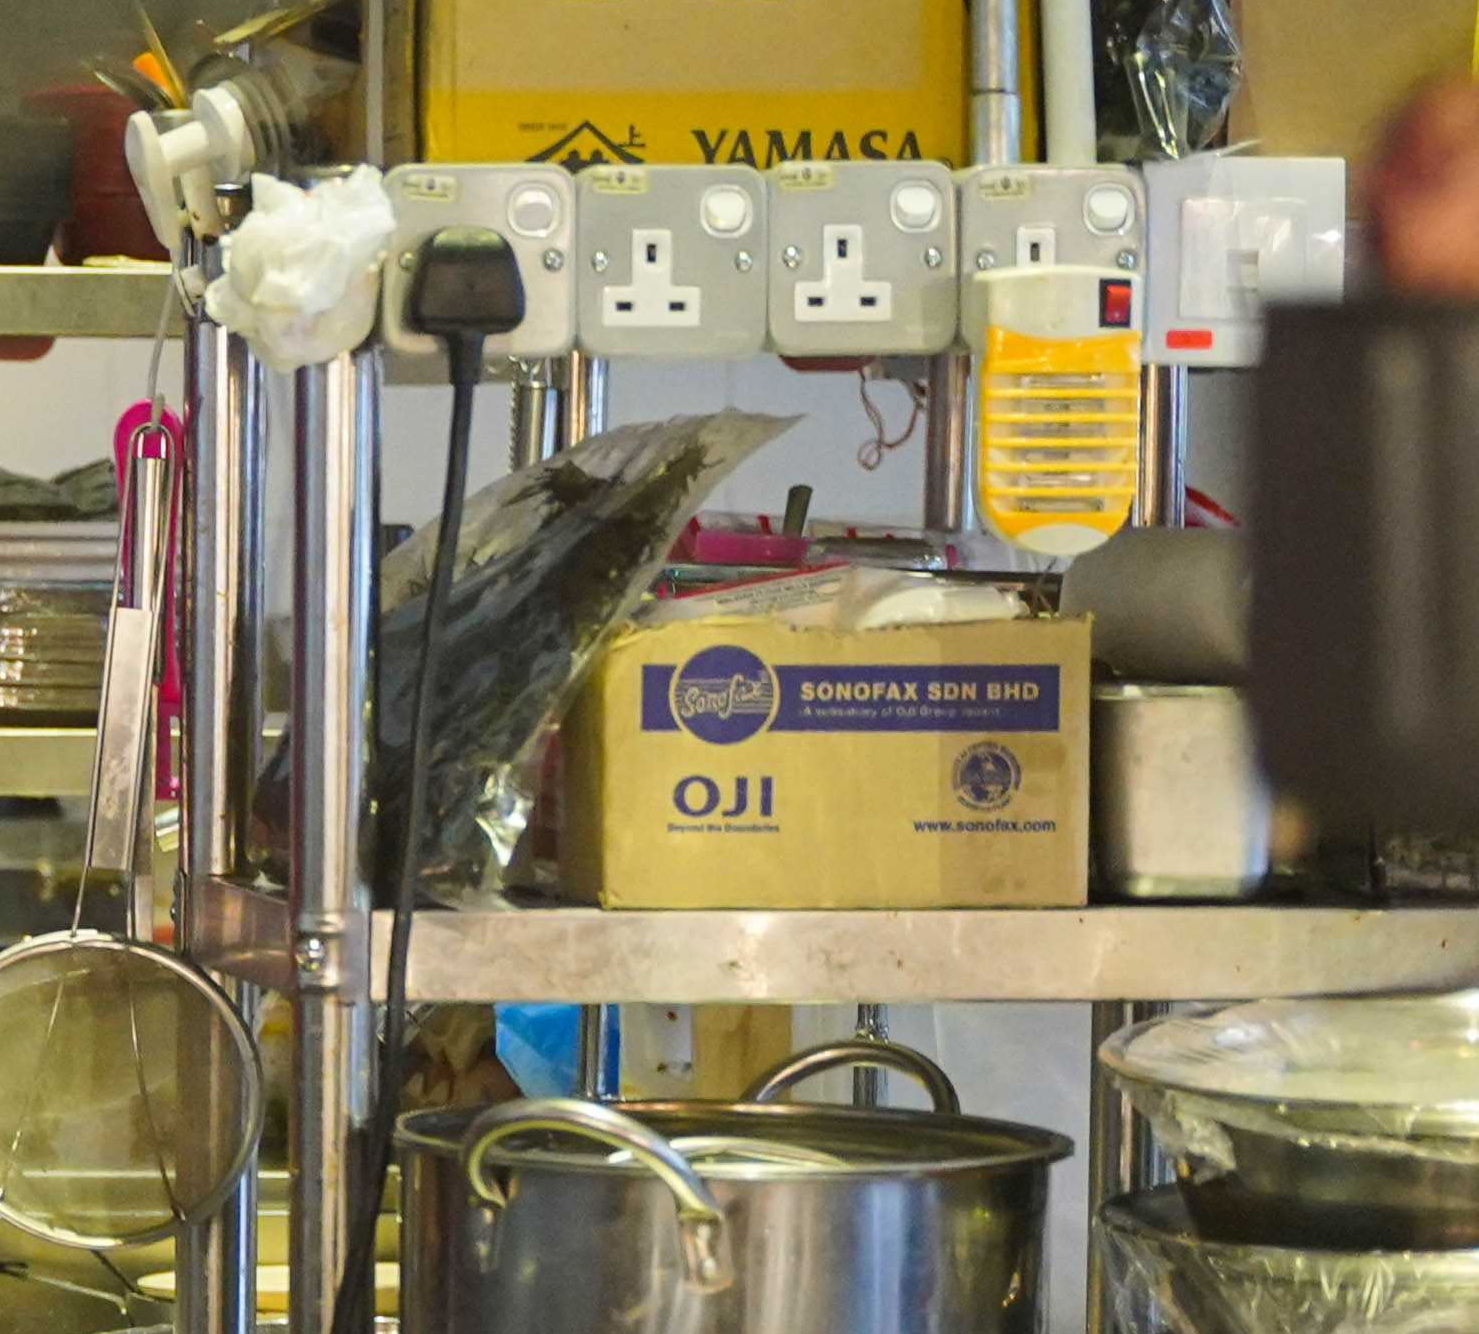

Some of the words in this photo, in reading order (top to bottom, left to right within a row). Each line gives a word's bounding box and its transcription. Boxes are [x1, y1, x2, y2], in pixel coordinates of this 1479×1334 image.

[692, 130, 923, 168] YAMASA
[800, 682, 918, 701] SONOFAX
[927, 682, 977, 701] SDN
[986, 682, 1040, 701] BHD
[672, 775, 773, 817] OJI
[913, 818, 1057, 833] www.sonofax.com
